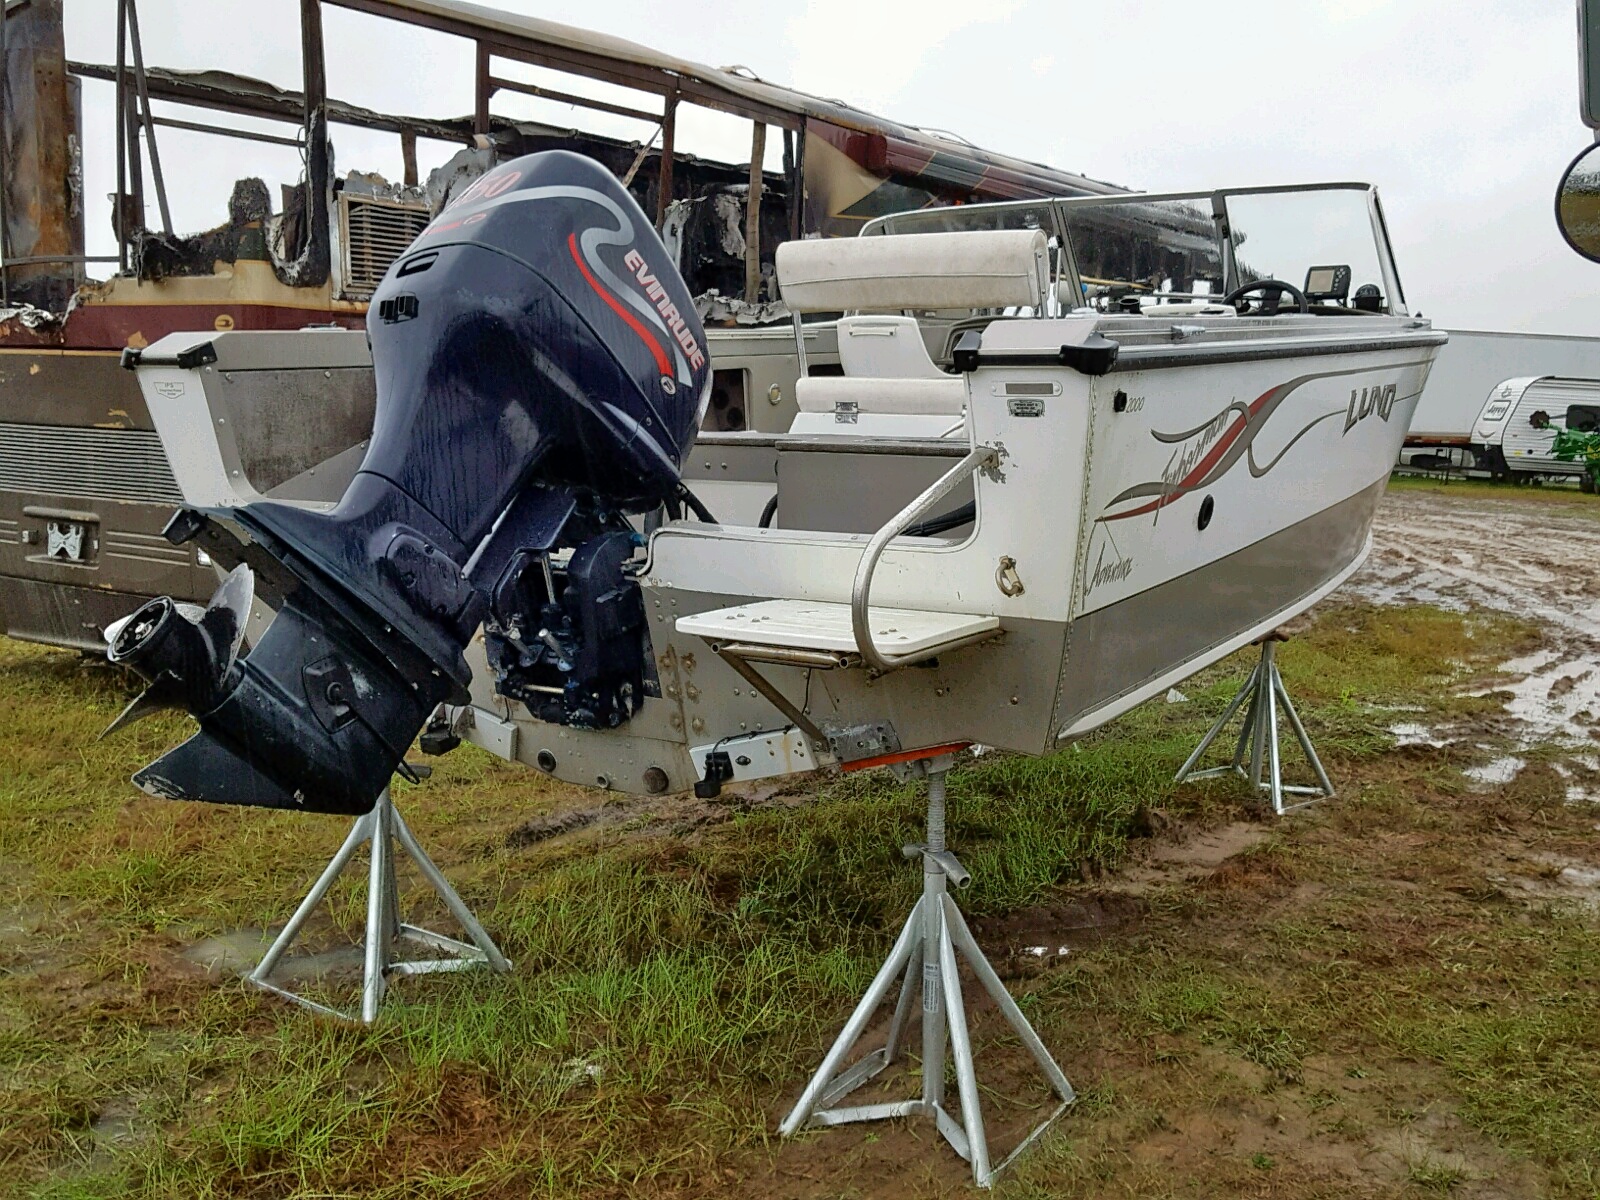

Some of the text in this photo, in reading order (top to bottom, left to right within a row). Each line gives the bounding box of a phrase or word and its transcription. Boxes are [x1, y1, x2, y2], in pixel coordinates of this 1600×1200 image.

[624, 249, 705, 371] EVINRUDE
[1126, 397, 1145, 413] 2000
[1342, 384, 1397, 437] LUND
